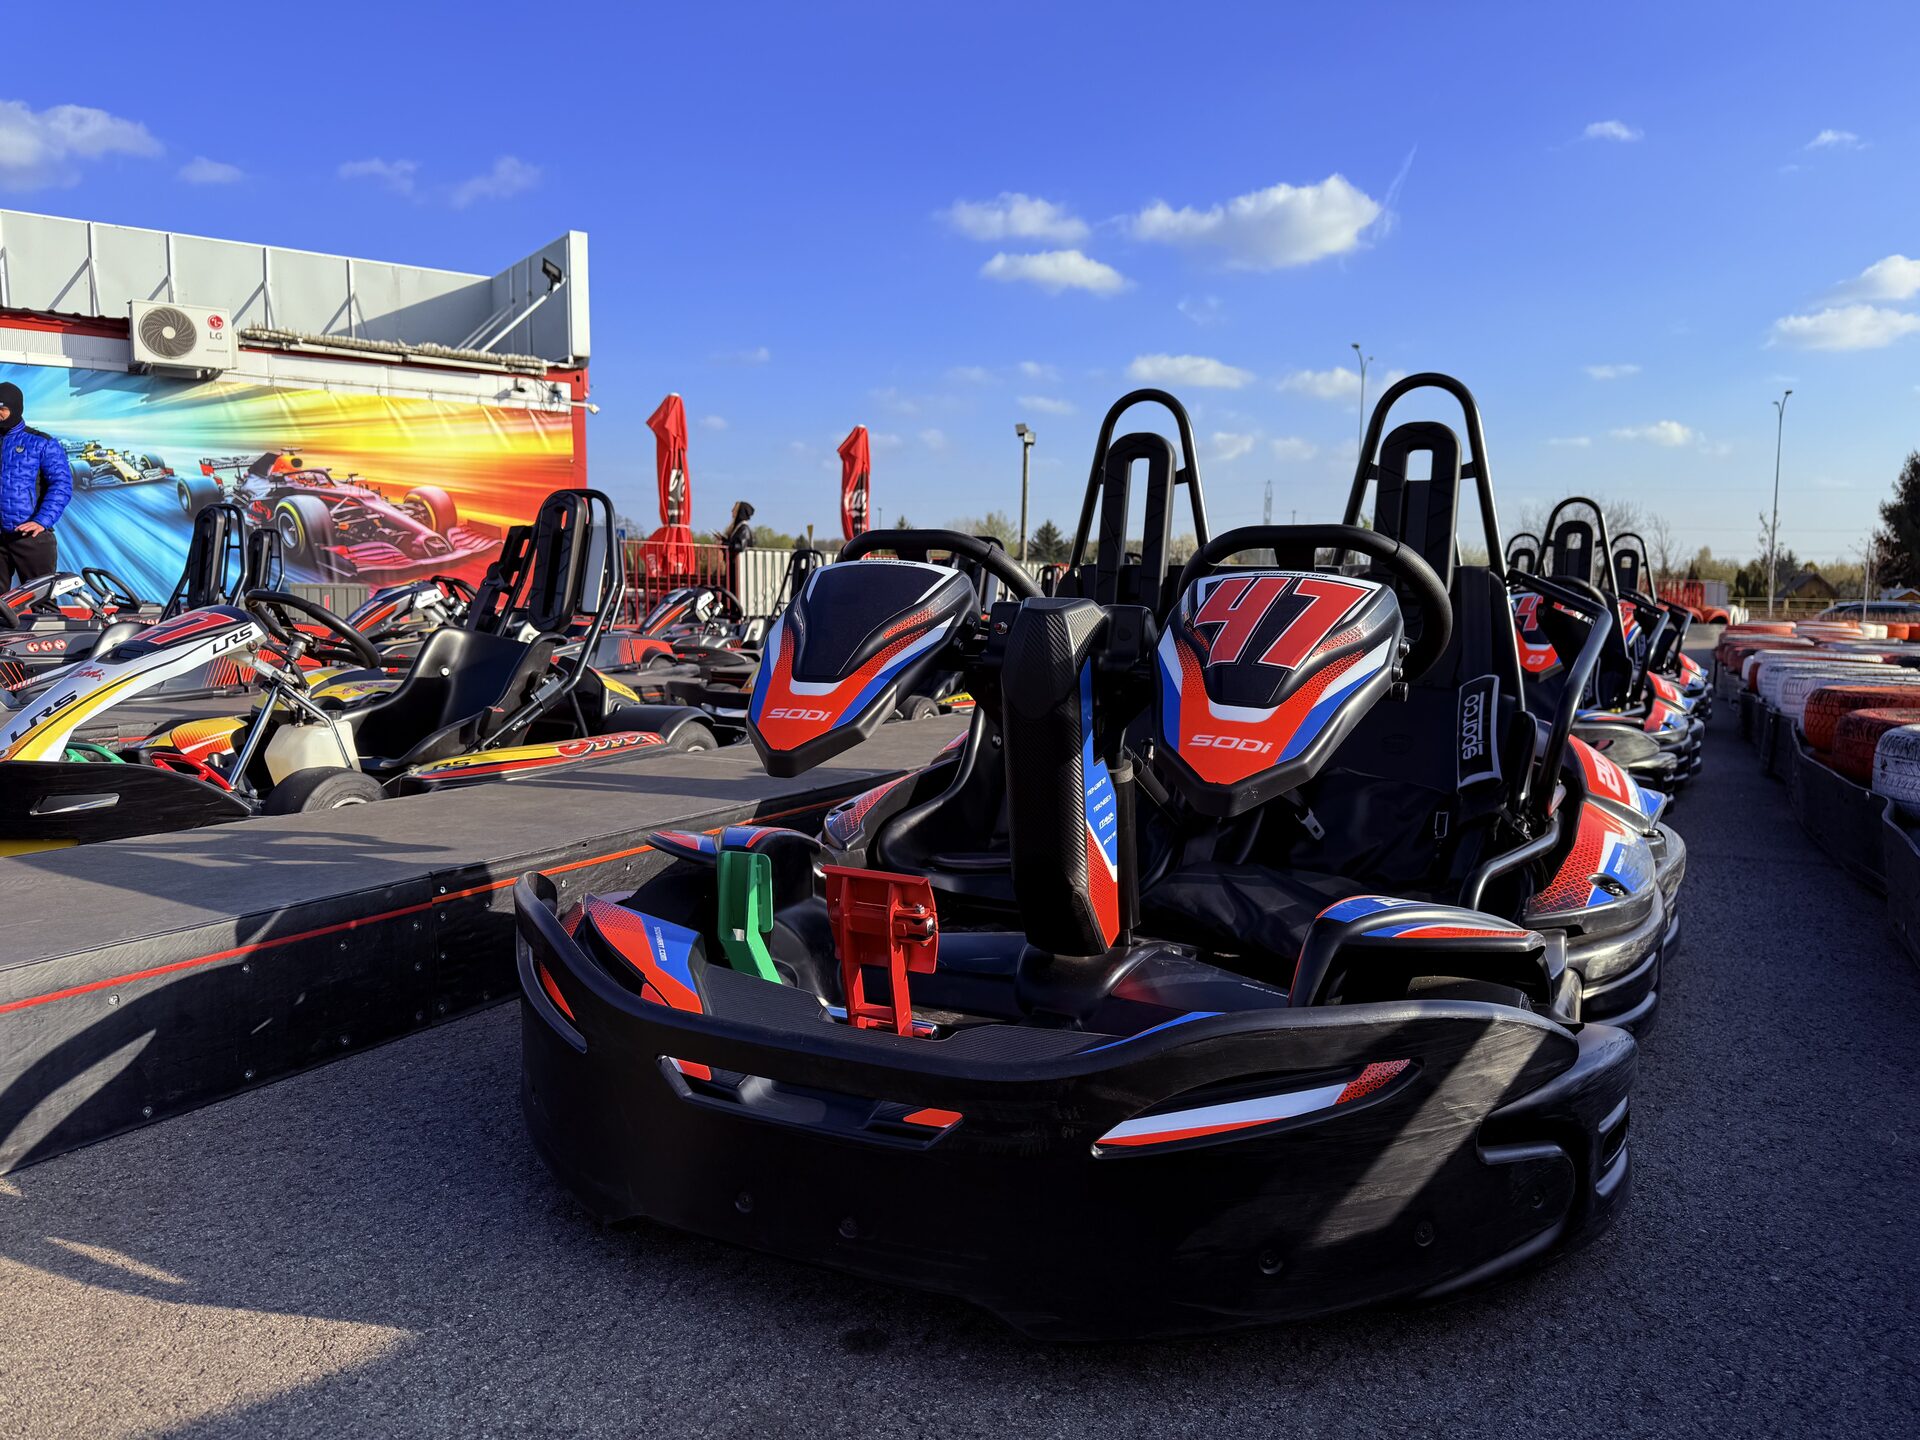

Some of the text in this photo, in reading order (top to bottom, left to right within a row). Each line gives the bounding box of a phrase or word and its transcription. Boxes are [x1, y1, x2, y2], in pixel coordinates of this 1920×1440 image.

[209, 331, 223, 341] LG
[766, 707, 833, 722] SODI
[1462, 694, 1485, 760] sparco
[1187, 734, 1275, 754] SODI
